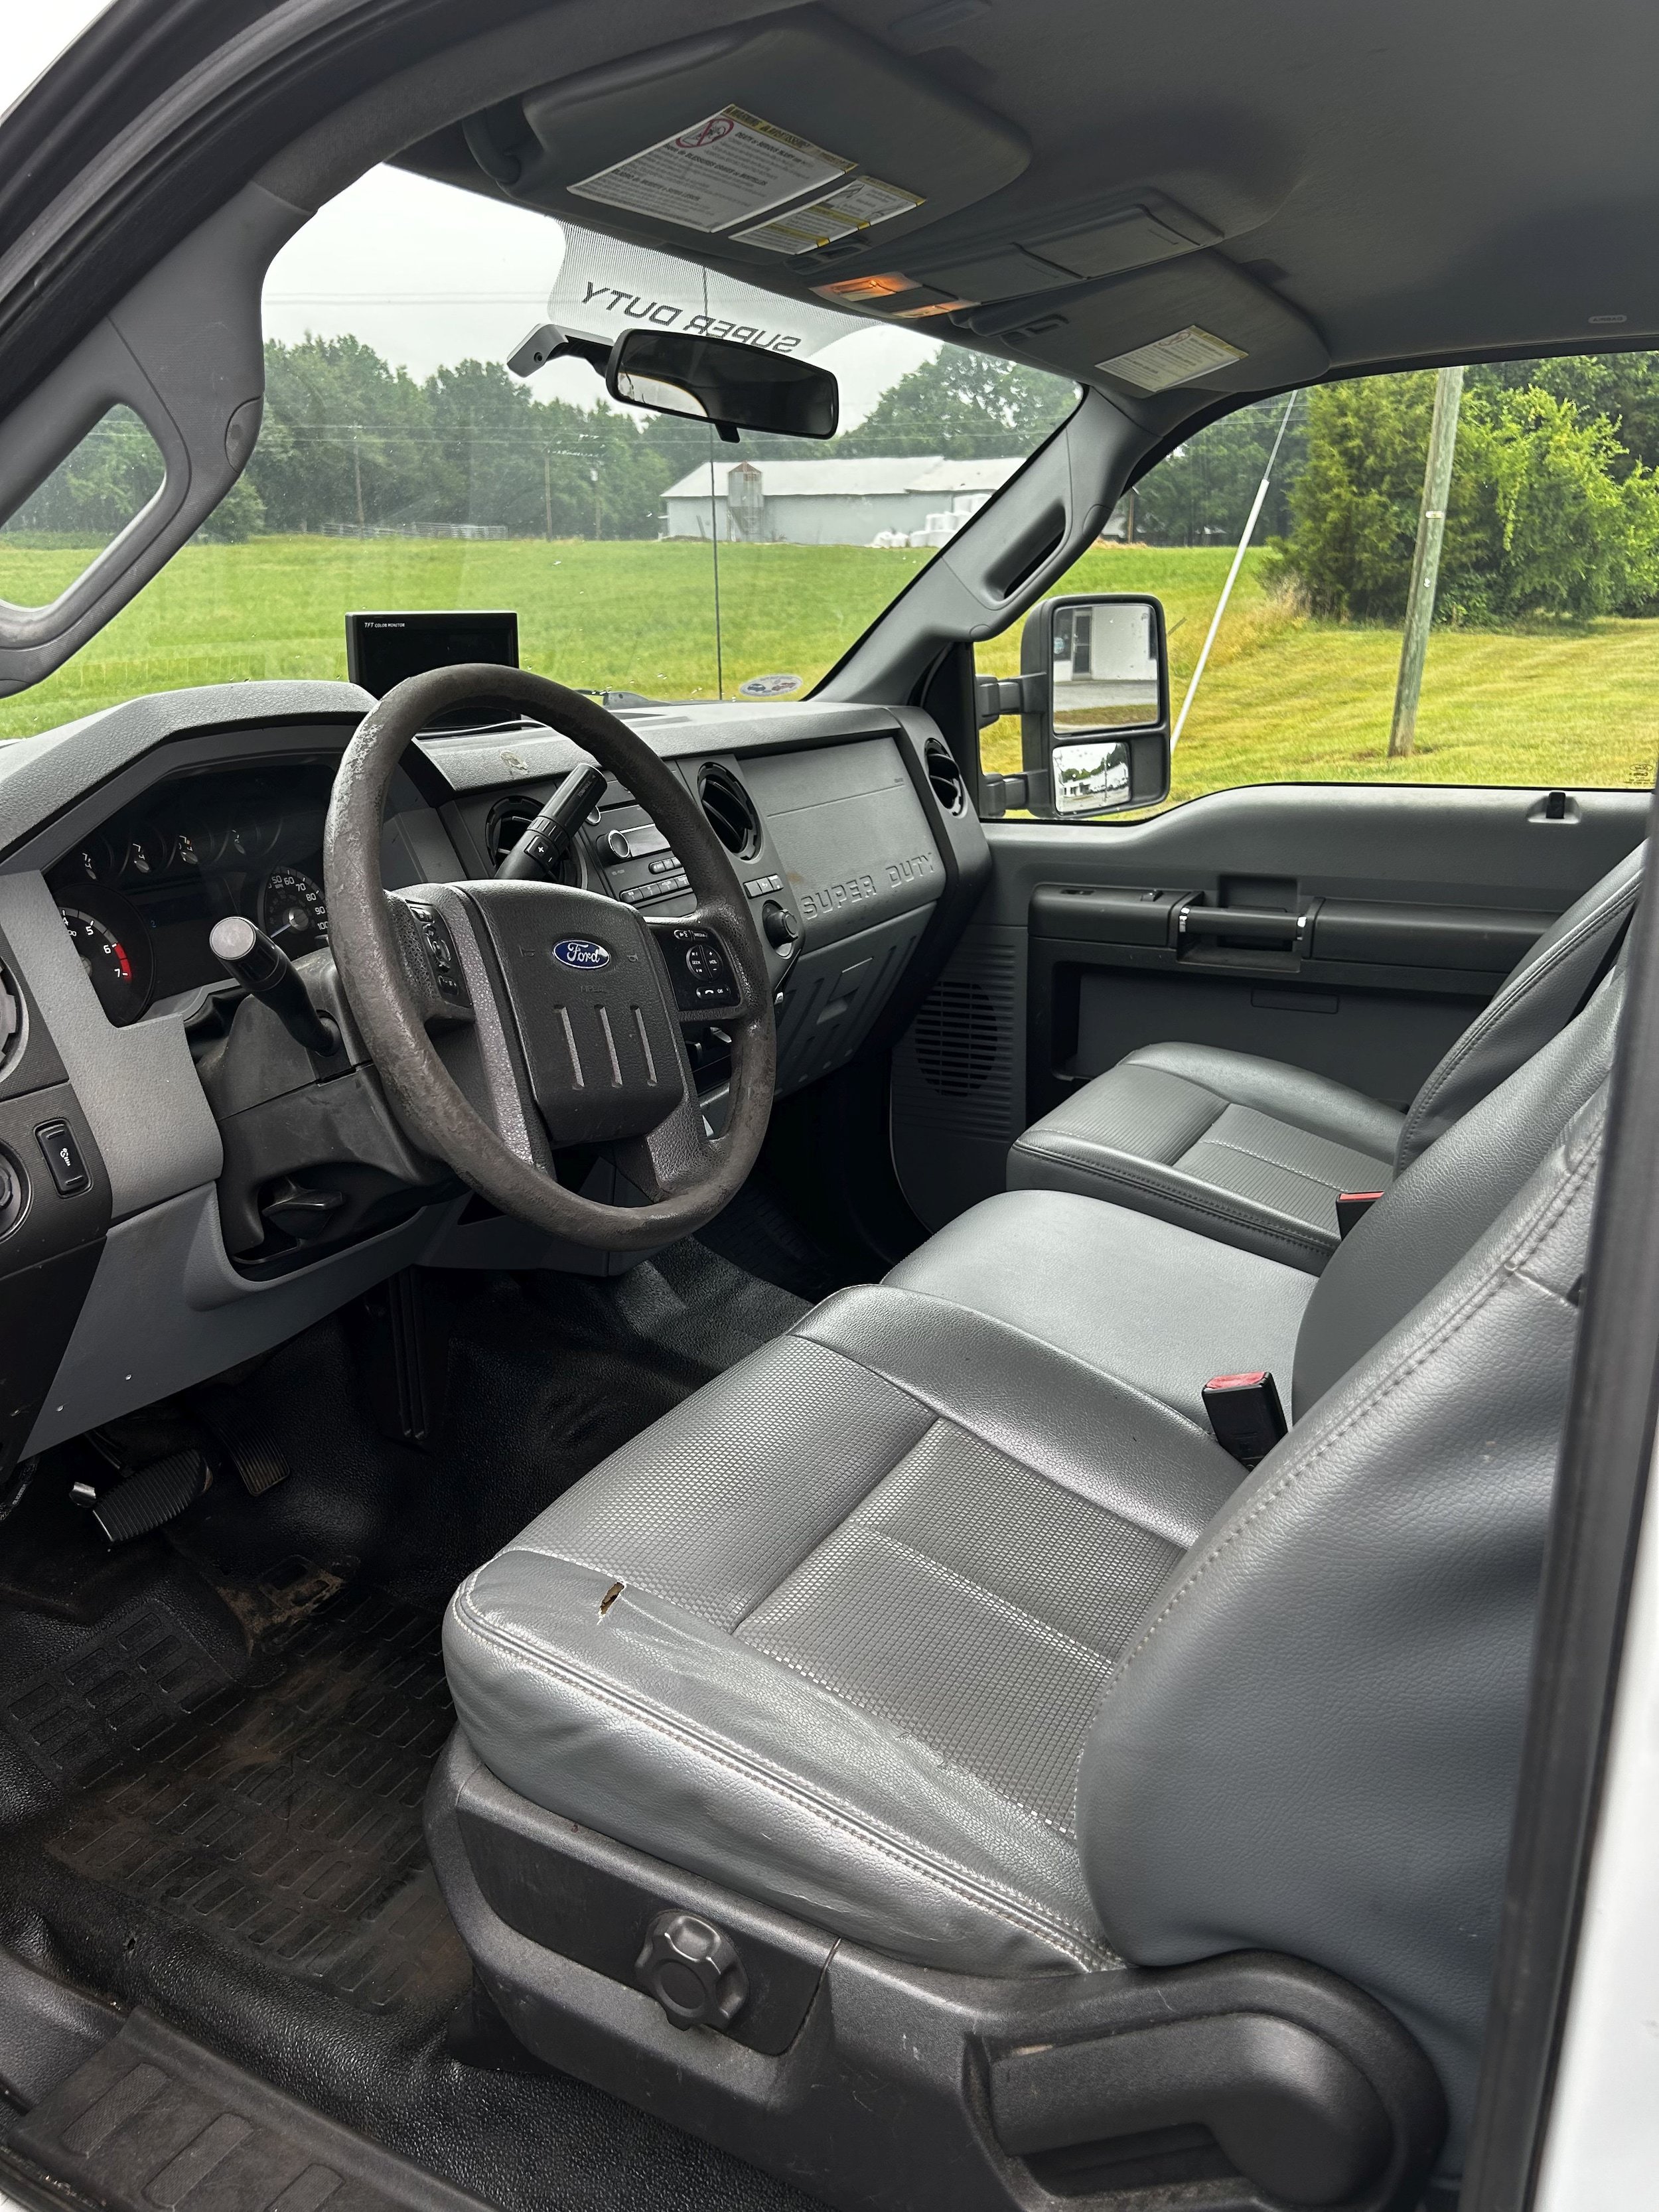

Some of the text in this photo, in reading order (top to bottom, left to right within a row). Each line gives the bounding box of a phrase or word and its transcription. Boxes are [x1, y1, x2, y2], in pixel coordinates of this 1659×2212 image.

[271, 875, 282, 884] 50
[284, 877, 295, 885] 60
[801, 852, 934, 920] SUPER DUTY
[306, 893, 317, 901] 80
[315, 907, 325, 915] 90
[85, 926, 94, 936] 5
[103, 944, 111, 954] 6
[567, 942, 601, 963] Ford
[114, 968, 121, 978] 7
